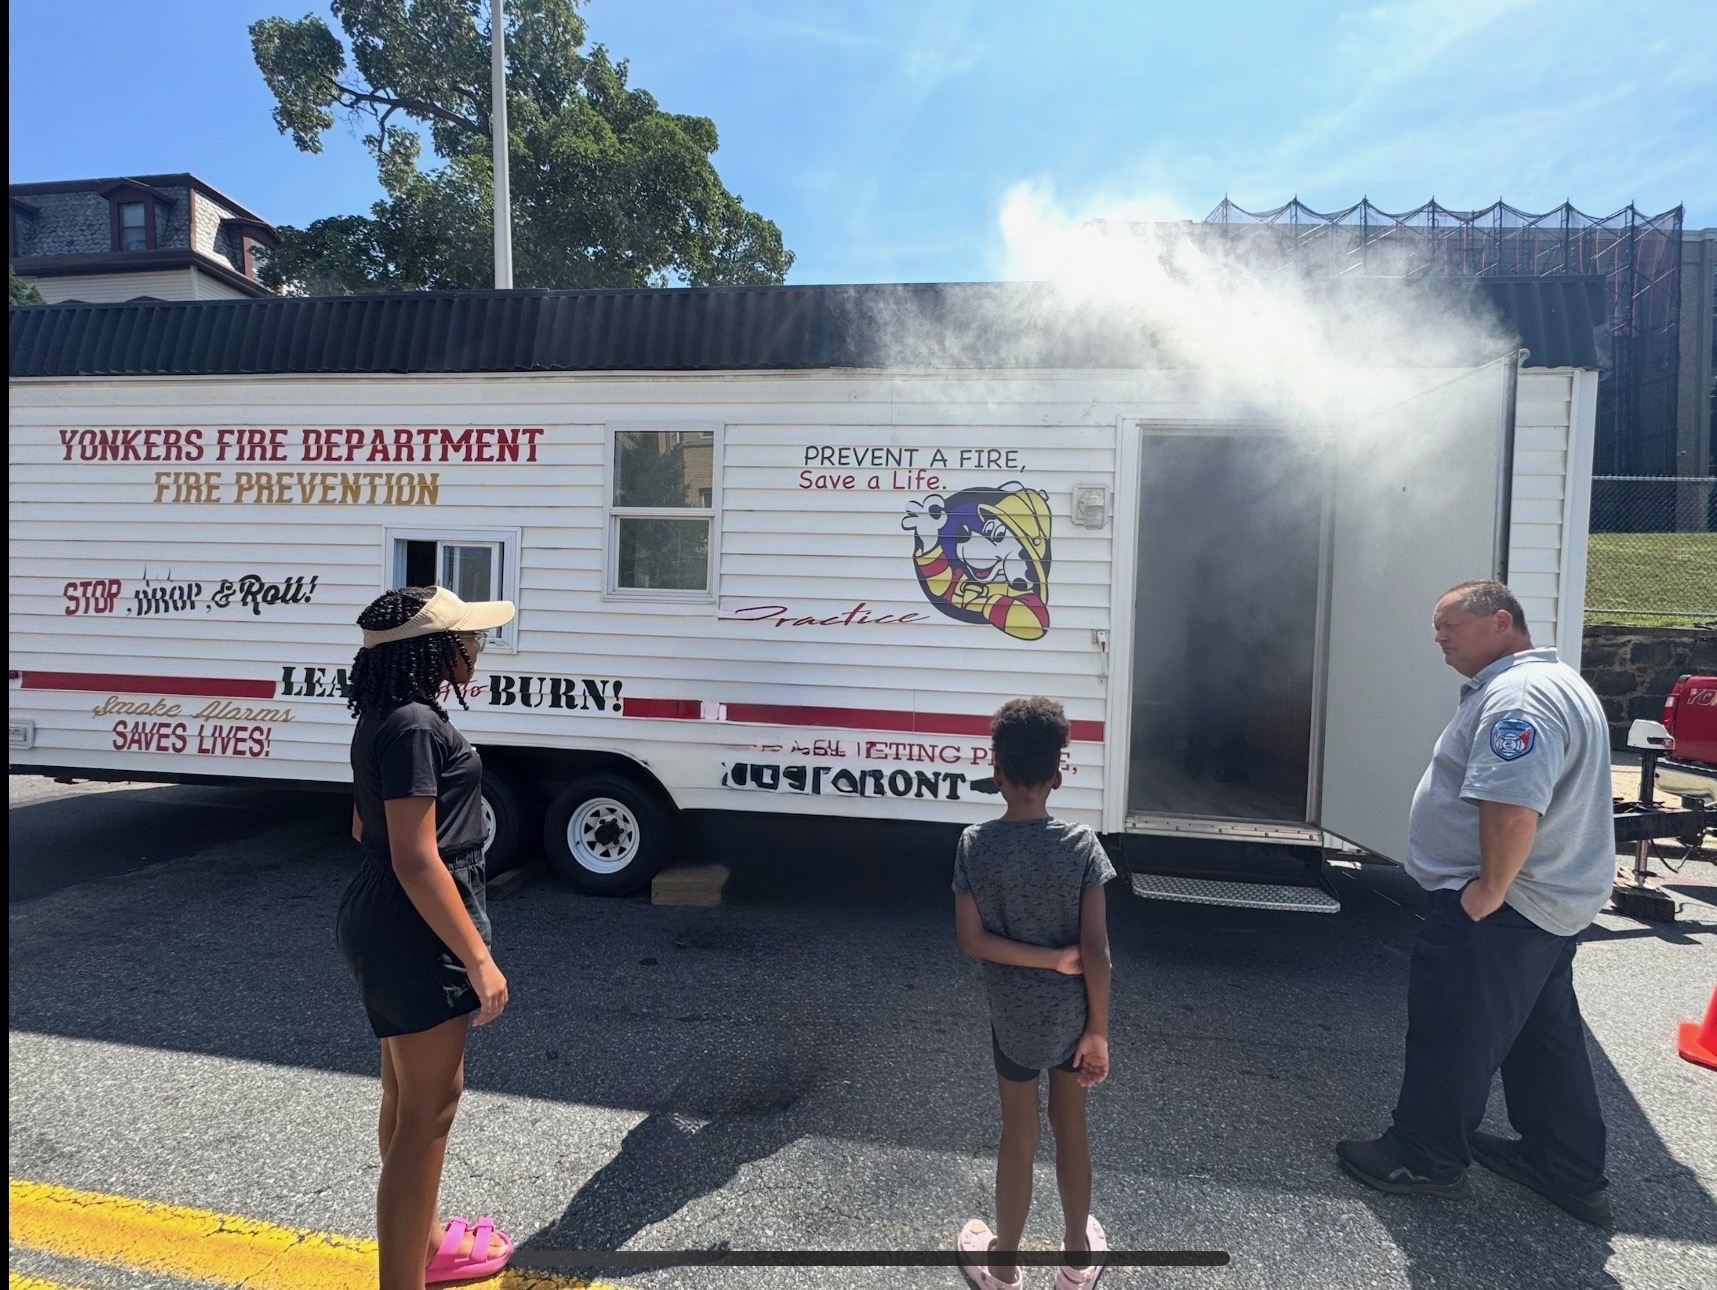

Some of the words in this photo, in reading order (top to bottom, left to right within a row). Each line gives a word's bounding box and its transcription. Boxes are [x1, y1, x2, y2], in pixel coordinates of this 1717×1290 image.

[59, 429, 204, 462] YONKERS
[216, 429, 289, 462] FIRE
[301, 428, 544, 463] DEPARTMENT
[804, 445, 919, 467] PREVENT
[930, 448, 948, 468] A
[959, 449, 1026, 473] FIRE,
[153, 471, 222, 503] FIRE
[234, 471, 440, 505] PREVENTION
[799, 470, 855, 490] Save
[867, 475, 880, 490] a
[892, 469, 947, 490] Life.
[282, 666, 350, 698] LEA
[489, 675, 623, 712] BURN!
[92, 695, 182, 719] Smoke
[191, 700, 295, 722] Alarms
[112, 720, 187, 753] SAVES
[197, 724, 272, 757] LIVES!
